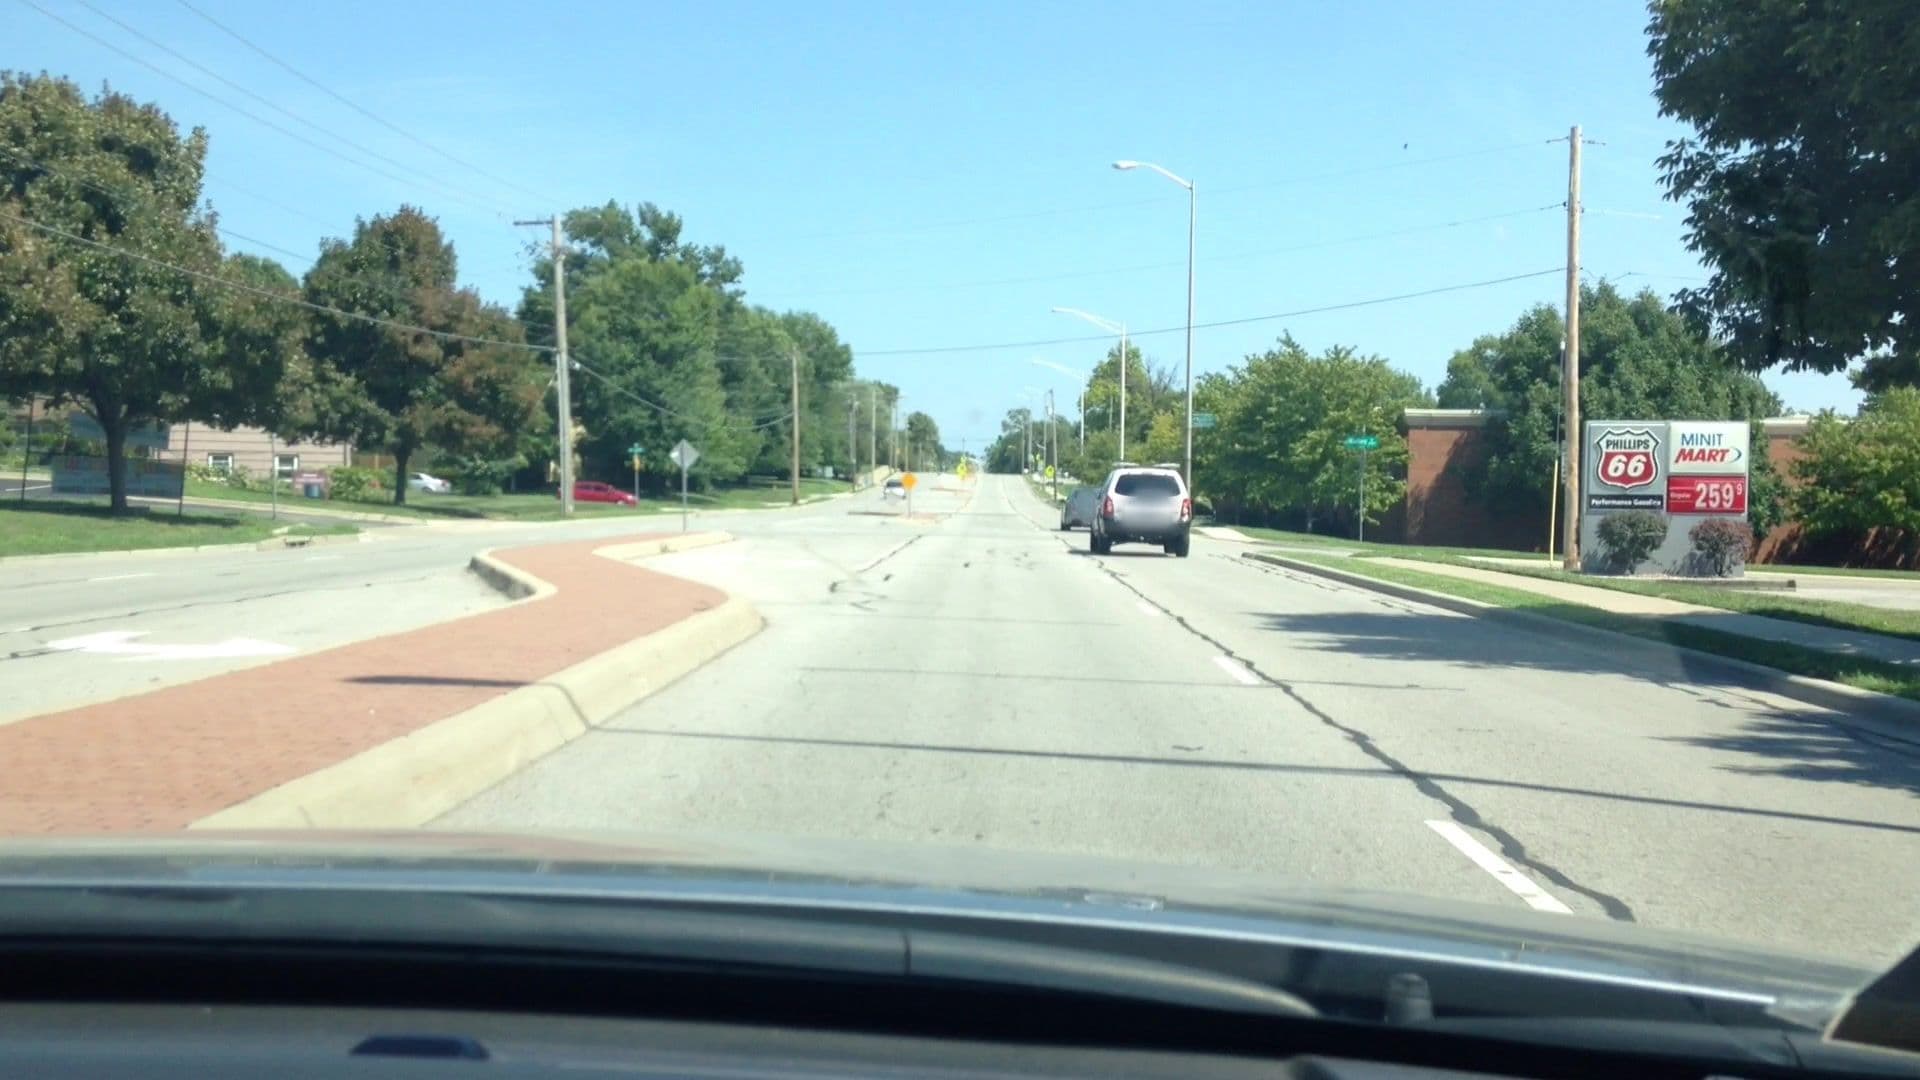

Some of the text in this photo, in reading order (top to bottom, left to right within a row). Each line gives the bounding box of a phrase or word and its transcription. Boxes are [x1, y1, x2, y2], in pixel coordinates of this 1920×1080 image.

[1606, 439, 1650, 450] PHILLIPS
[1681, 433, 1723, 446] MINIT
[1675, 448, 1730, 463] MART
[1608, 454, 1647, 477] 66
